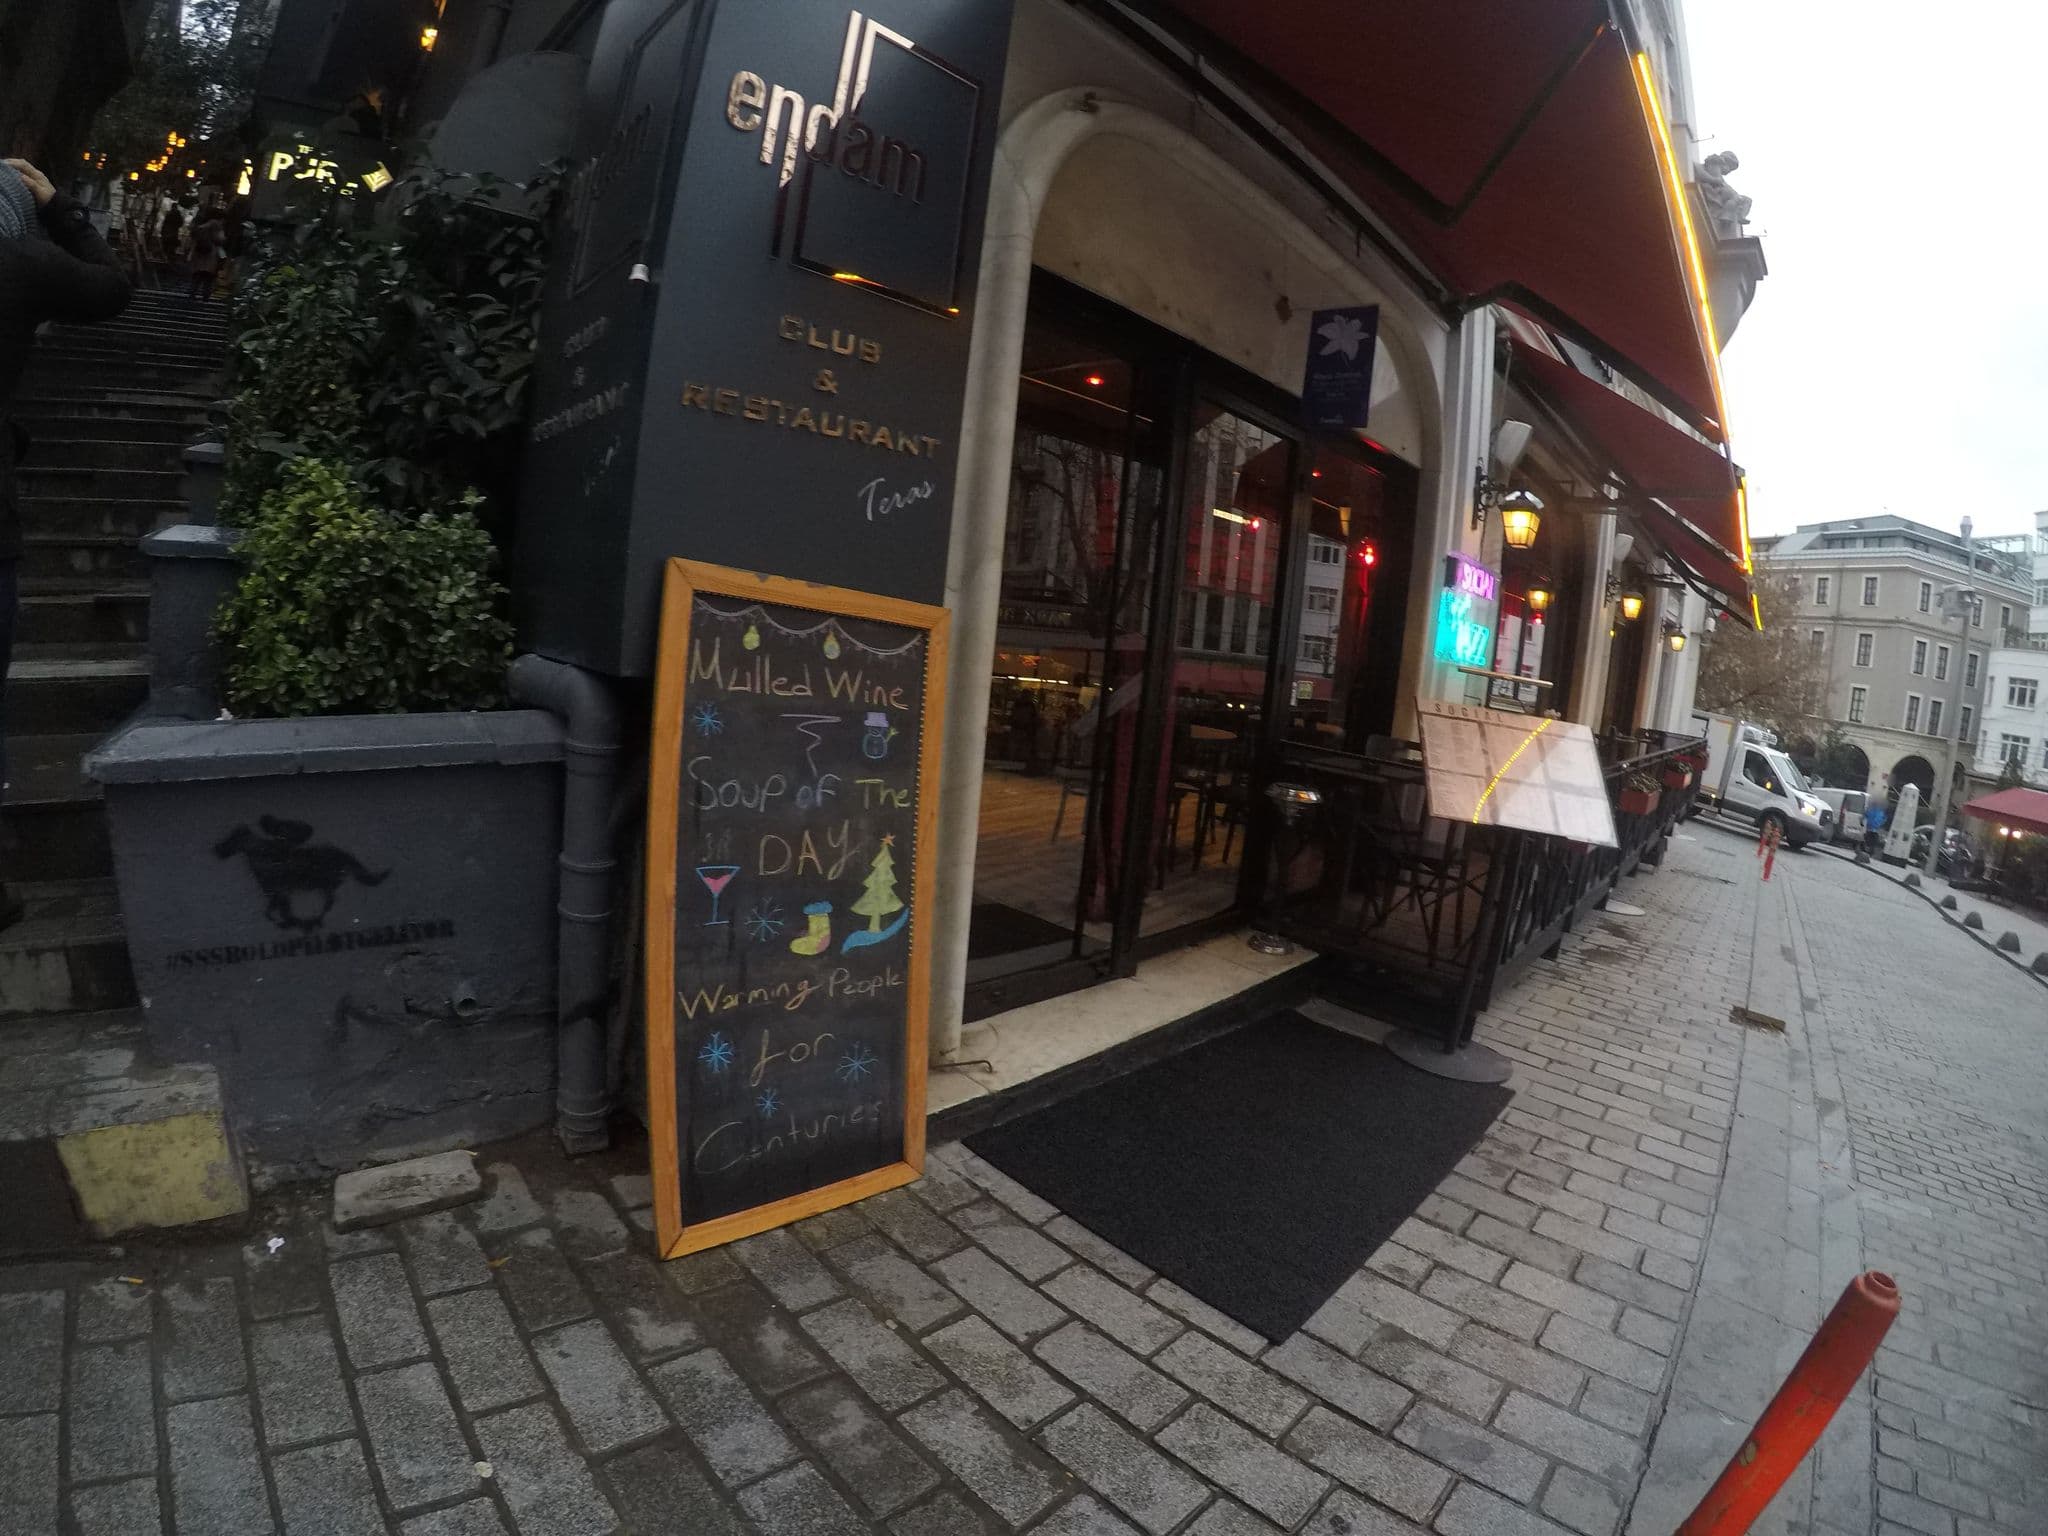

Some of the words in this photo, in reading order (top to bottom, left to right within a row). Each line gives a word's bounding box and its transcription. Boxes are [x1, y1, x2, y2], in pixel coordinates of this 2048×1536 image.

[778, 314, 882, 365] CLUB
[813, 368, 839, 395] &
[682, 380, 943, 459] RESTAURANT
[689, 636, 813, 697] Mulled
[825, 666, 909, 711] Wine
[854, 778, 912, 809] The
